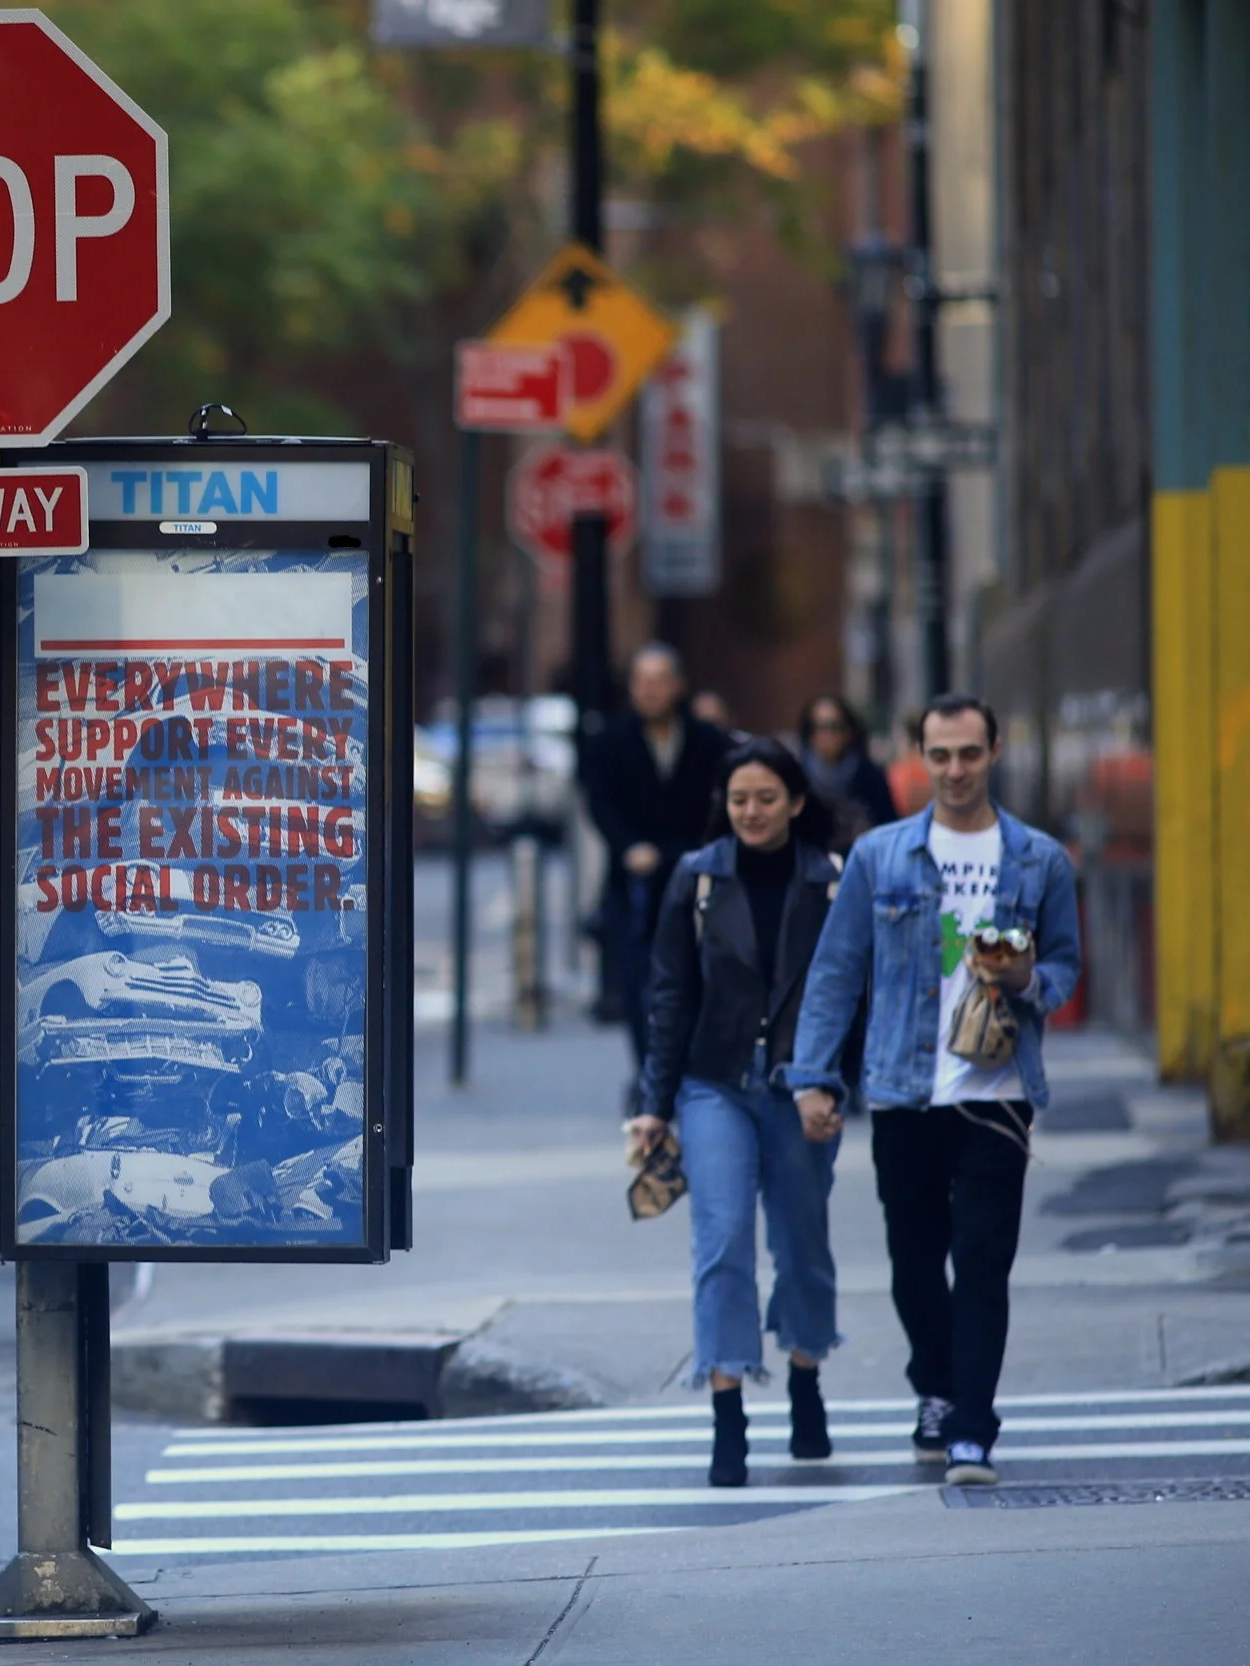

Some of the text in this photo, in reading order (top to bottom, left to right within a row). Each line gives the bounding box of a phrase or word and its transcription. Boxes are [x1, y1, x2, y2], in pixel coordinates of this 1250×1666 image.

[111, 471, 279, 515] TITAN
[173, 524, 202, 532] TITAN
[36, 660, 354, 712] EVERYWHERE
[35, 717, 354, 761] SUPPORT EVERY
[36, 766, 354, 801] MOVEMENT AGAINST
[36, 806, 354, 860] THE EXISTING
[36, 862, 354, 913] SOCIAL ORDER.
